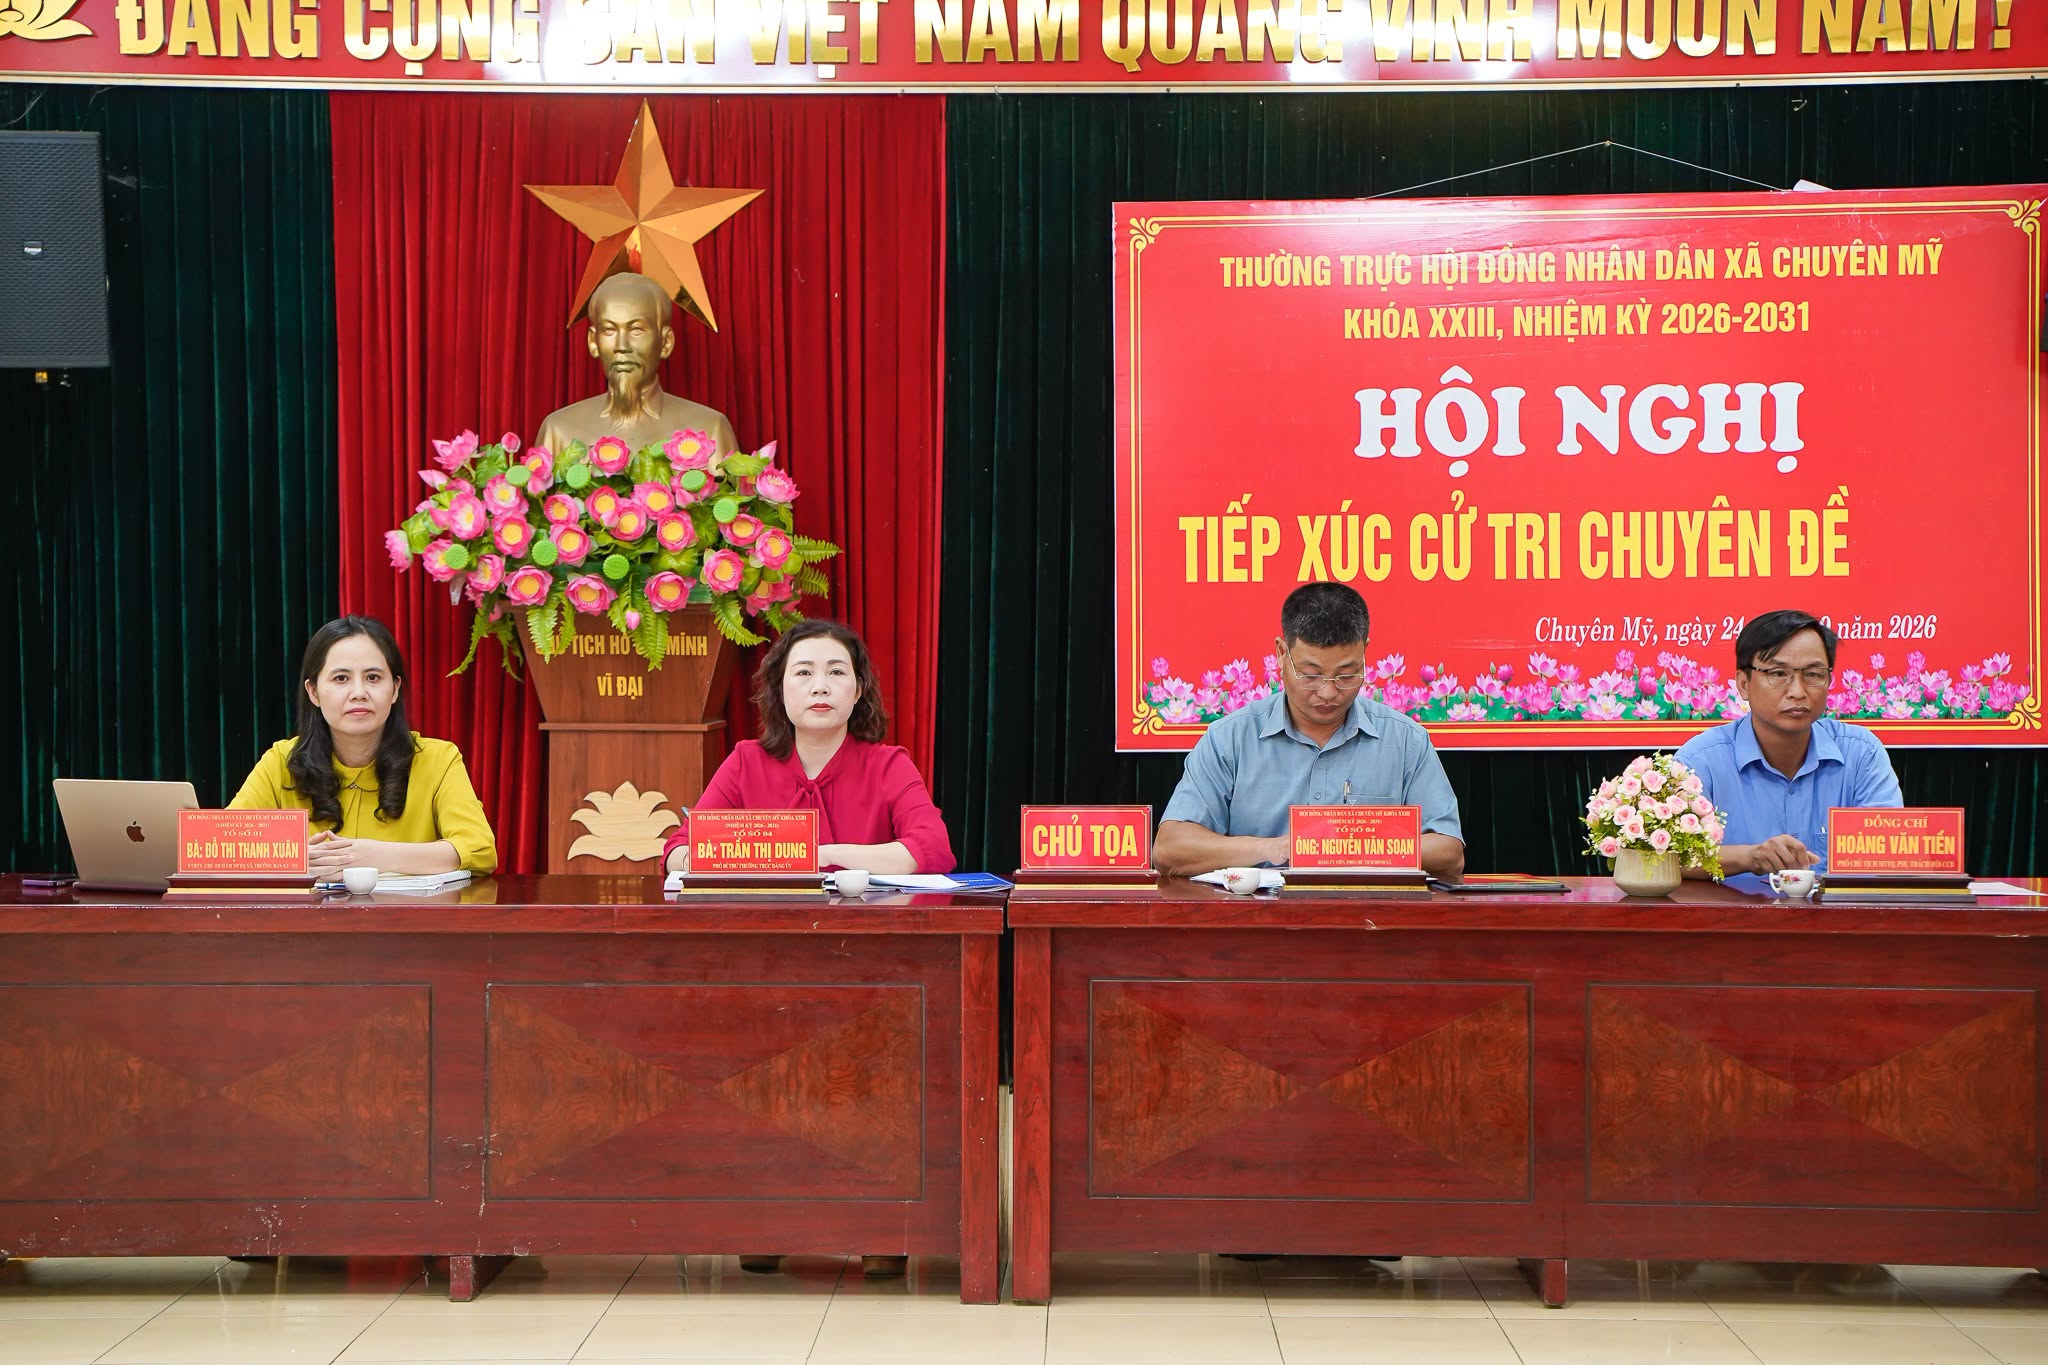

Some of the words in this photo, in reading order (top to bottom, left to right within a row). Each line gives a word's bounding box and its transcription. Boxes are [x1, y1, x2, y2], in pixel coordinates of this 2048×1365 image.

[914, 0, 1079, 63] NAM
[1219, 249, 1331, 287] THƯỜNG
[1340, 252, 1412, 292] TRỰC
[1421, 247, 1468, 291] HỘI
[1477, 242, 1556, 283] ĐỒNG
[1565, 244, 1645, 282] NHÂN
[1655, 243, 1715, 280] DÂN
[1724, 241, 1763, 279] XÃ
[1772, 239, 1888, 278] CHUYÊN
[1898, 237, 1943, 276] MỸ
[1344, 301, 1420, 339] KHÓA
[1429, 306, 1504, 341] XXIII,
[1513, 298, 1607, 343] NHIỆM
[1616, 297, 1652, 335] KỲ
[1661, 301, 1809, 334] 2026-2031
[1354, 365, 1526, 478] HỘI
[1555, 382, 1804, 474] NGHỊ
[1179, 493, 1281, 582] TIẾP
[1297, 500, 1392, 582] XÚC
[1410, 490, 1478, 582] CỬ
[1488, 512, 1560, 579] TRI
[1579, 495, 1771, 579] CHUYÊN
[1787, 486, 1849, 576] ĐỀ
[1535, 616, 1616, 647] Chuyên
[1620, 616, 1658, 646] Mỹ,
[1664, 618, 1716, 646] ngày
[1837, 616, 1883, 640] năm
[1888, 615, 1937, 640] 2026
[572, 634, 605, 658] TỊCH
[597, 673, 612, 696] VĨ
[616, 676, 643, 700] ĐẠI
[253, 829, 262, 837] 01
[763, 829, 772, 837] 04
[1864, 814, 1901, 828] ĐỒNG
[1904, 816, 1928, 828] CHÍ
[220, 842, 235, 862] THỊ
[238, 842, 270, 858] THANH
[272, 839, 299, 858] XUÂN
[697, 839, 716, 859] BÀ:
[720, 837, 750, 859] TRẦN
[753, 842, 771, 862] THỊ
[775, 842, 806, 859] DUNG
[1032, 814, 1082, 857] CHỦ
[1090, 825, 1138, 864] TỌA
[1296, 835, 1319, 855] ÔNG:
[1321, 832, 1361, 855] NGUYỄN
[1364, 835, 1384, 855] VĂN
[1387, 839, 1414, 859] SOẠN
[1836, 832, 1885, 854] HOÀNG
[1889, 832, 1919, 854] VĂN
